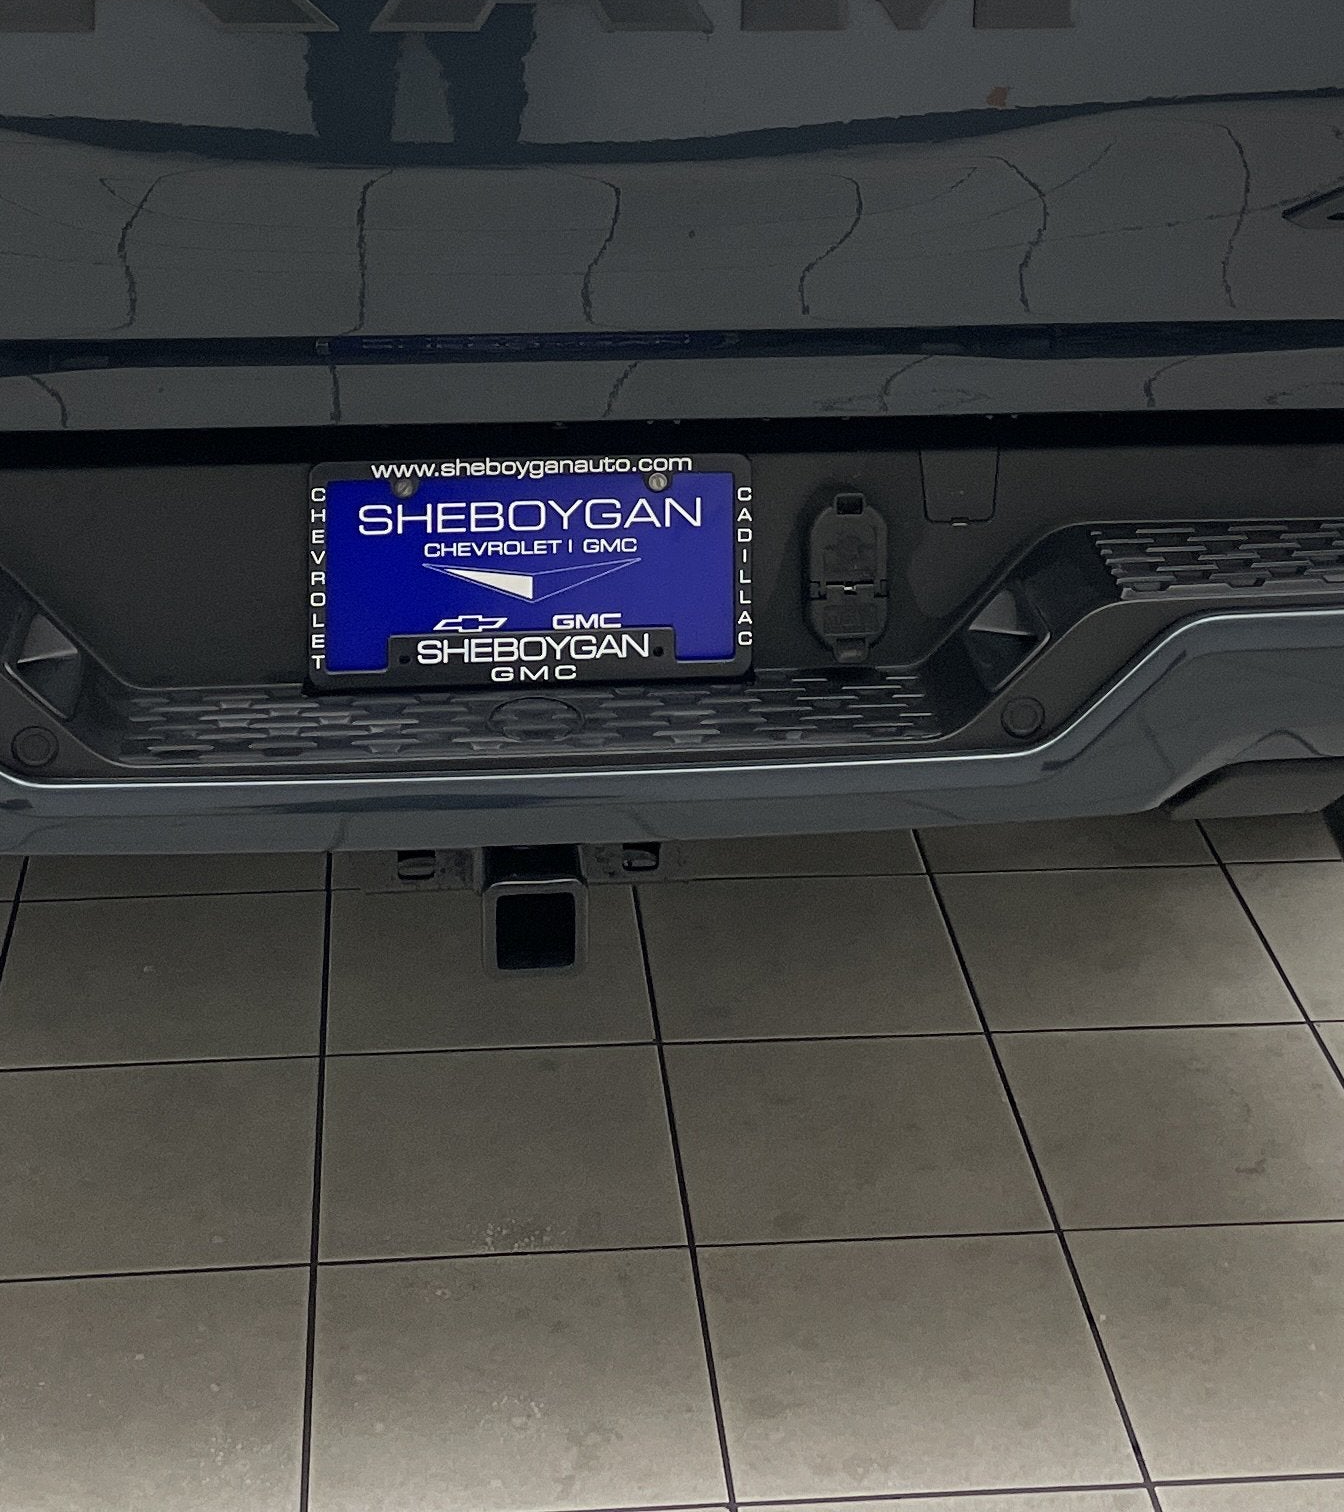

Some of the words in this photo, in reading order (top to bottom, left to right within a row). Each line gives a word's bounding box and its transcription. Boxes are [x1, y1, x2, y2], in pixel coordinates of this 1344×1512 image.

[370, 455, 693, 481] www.sheboyganauto.com
[357, 496, 702, 536] SHEBOYGAN
[423, 539, 562, 558] CHEVROLET
[582, 537, 638, 554] GMC
[309, 487, 327, 671] CHEVROLET
[736, 486, 753, 647] CADILLAC
[551, 612, 622, 630] GMC
[416, 632, 650, 665] SHEBOYGAN
[490, 665, 578, 682] GMC
